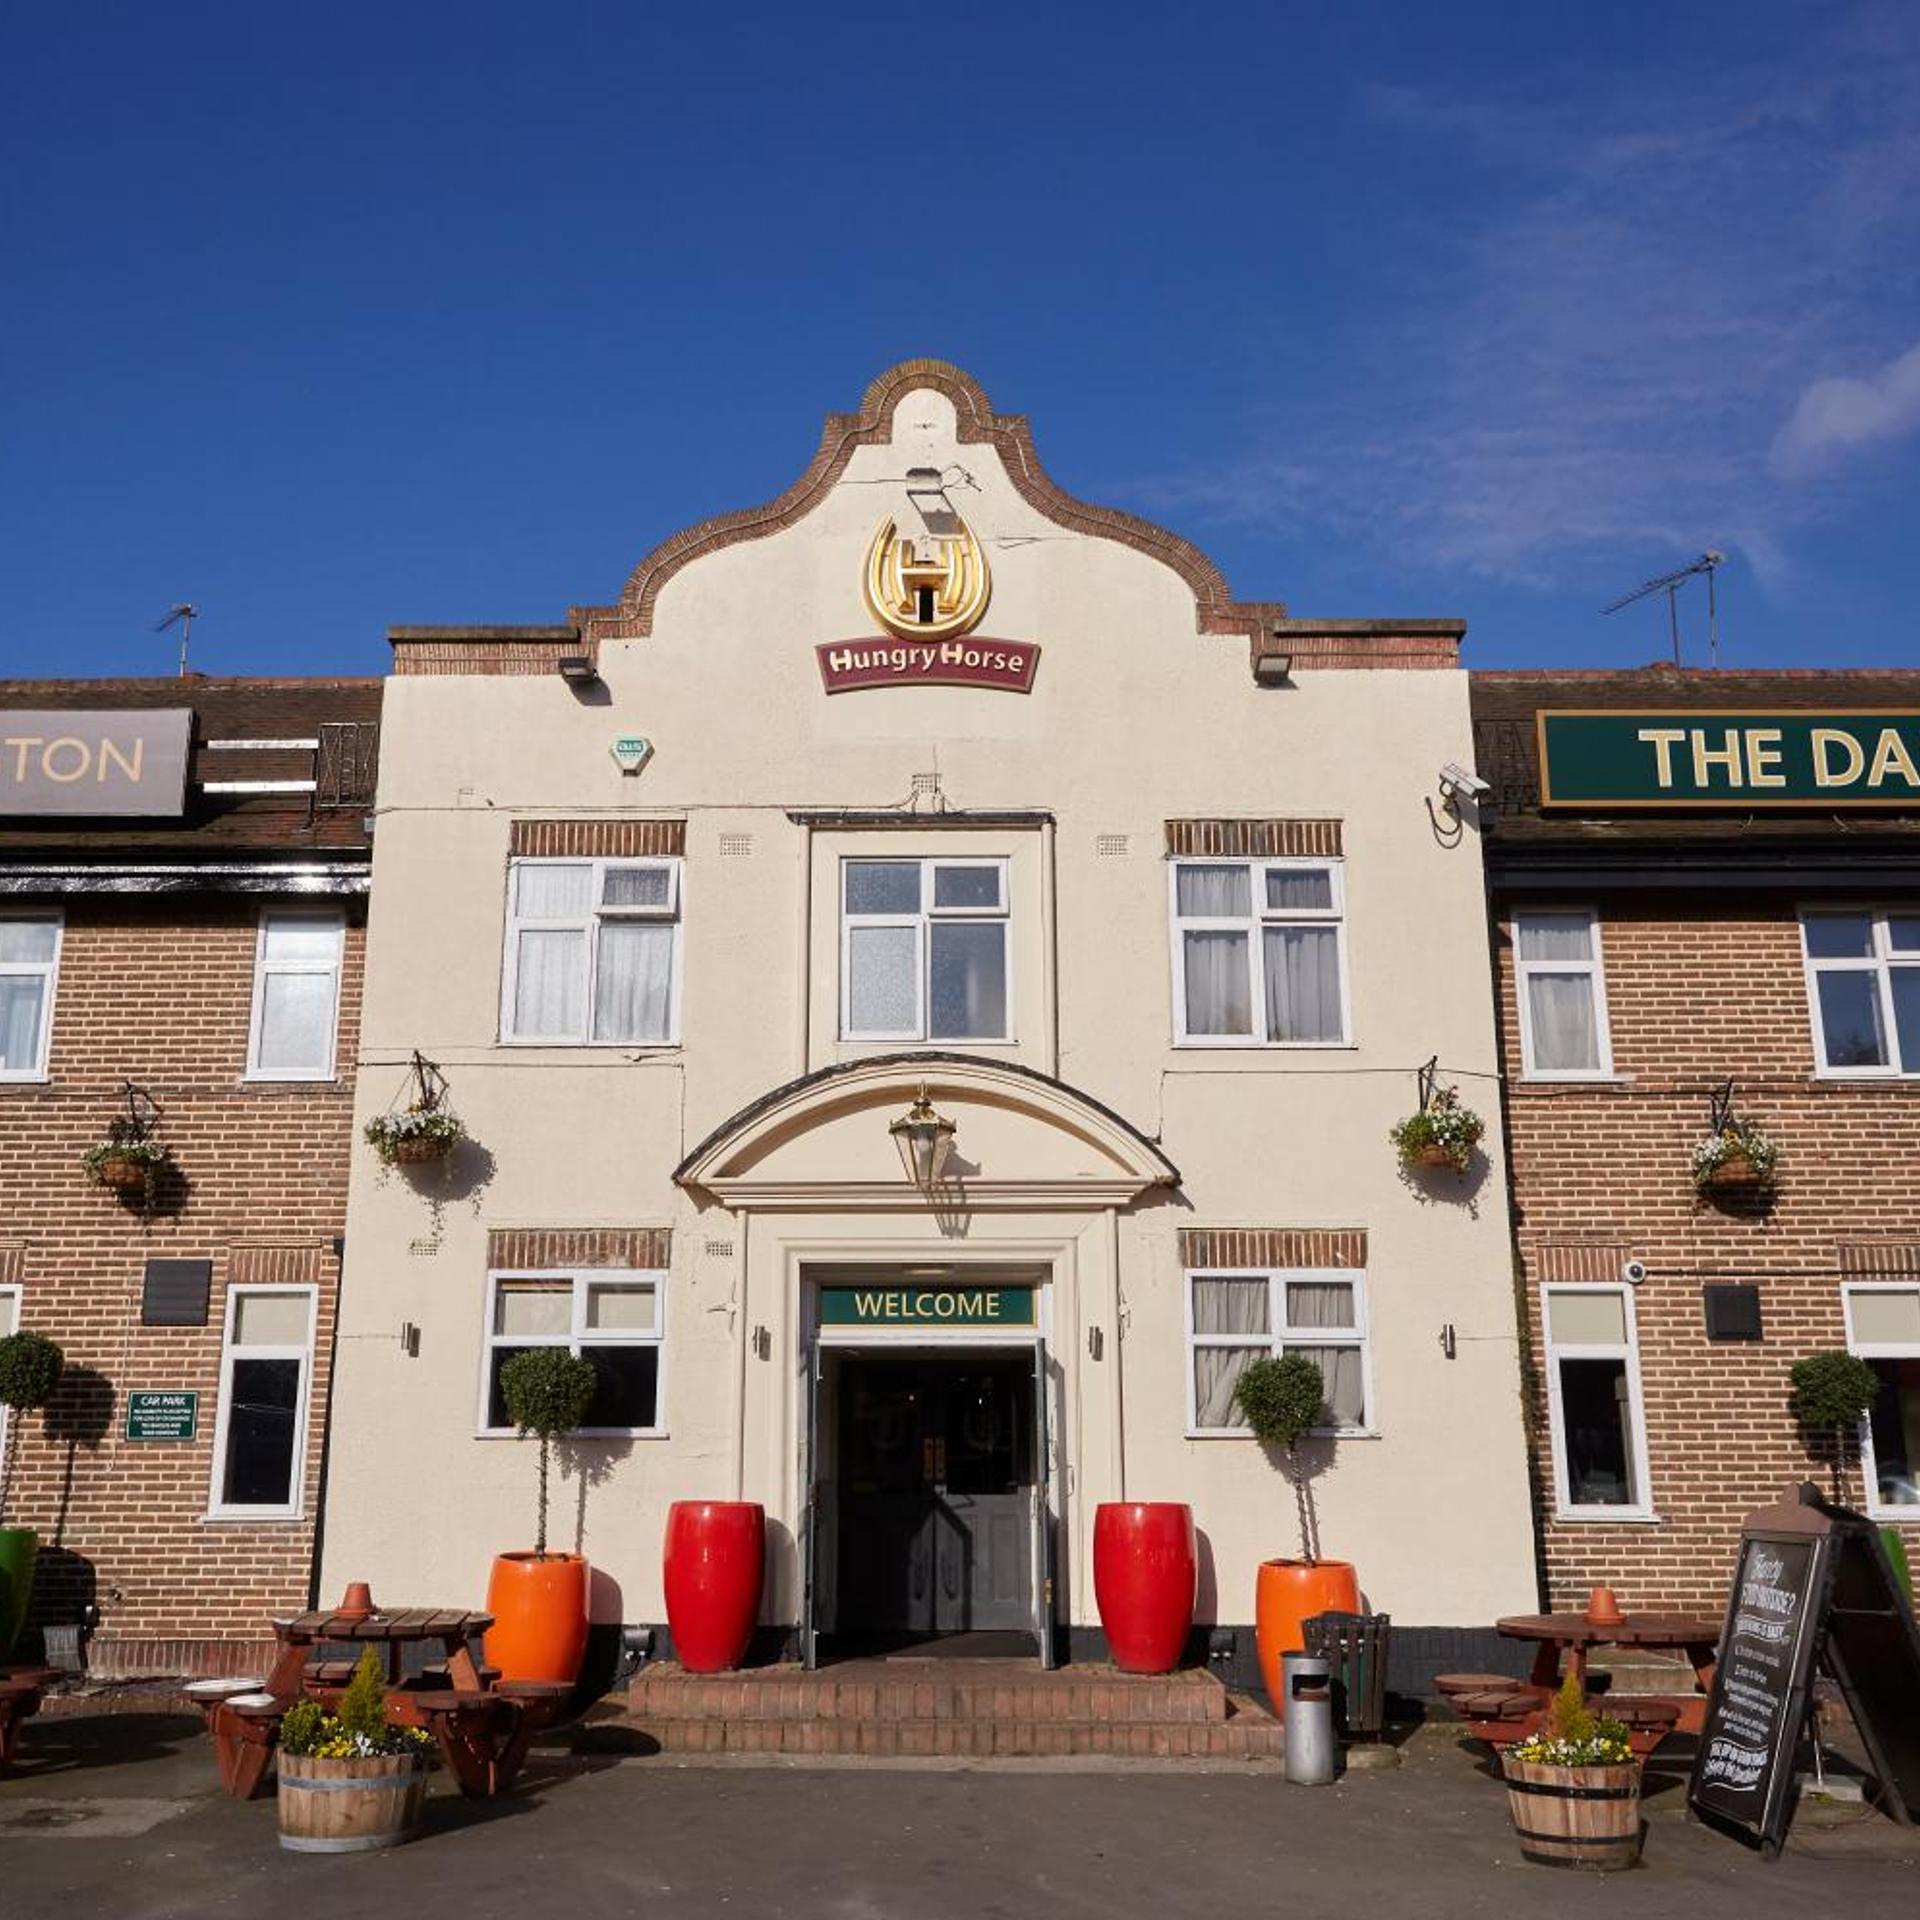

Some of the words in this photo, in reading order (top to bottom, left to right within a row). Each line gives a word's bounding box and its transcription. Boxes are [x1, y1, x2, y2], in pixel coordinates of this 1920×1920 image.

[4, 737, 144, 784] TON
[1637, 728, 1787, 788] THE
[1811, 728, 1920, 788] DA
[855, 1292, 1000, 1318] WELCOME
[140, 1396, 160, 1406] CAR
[162, 1396, 186, 1406] PARK
